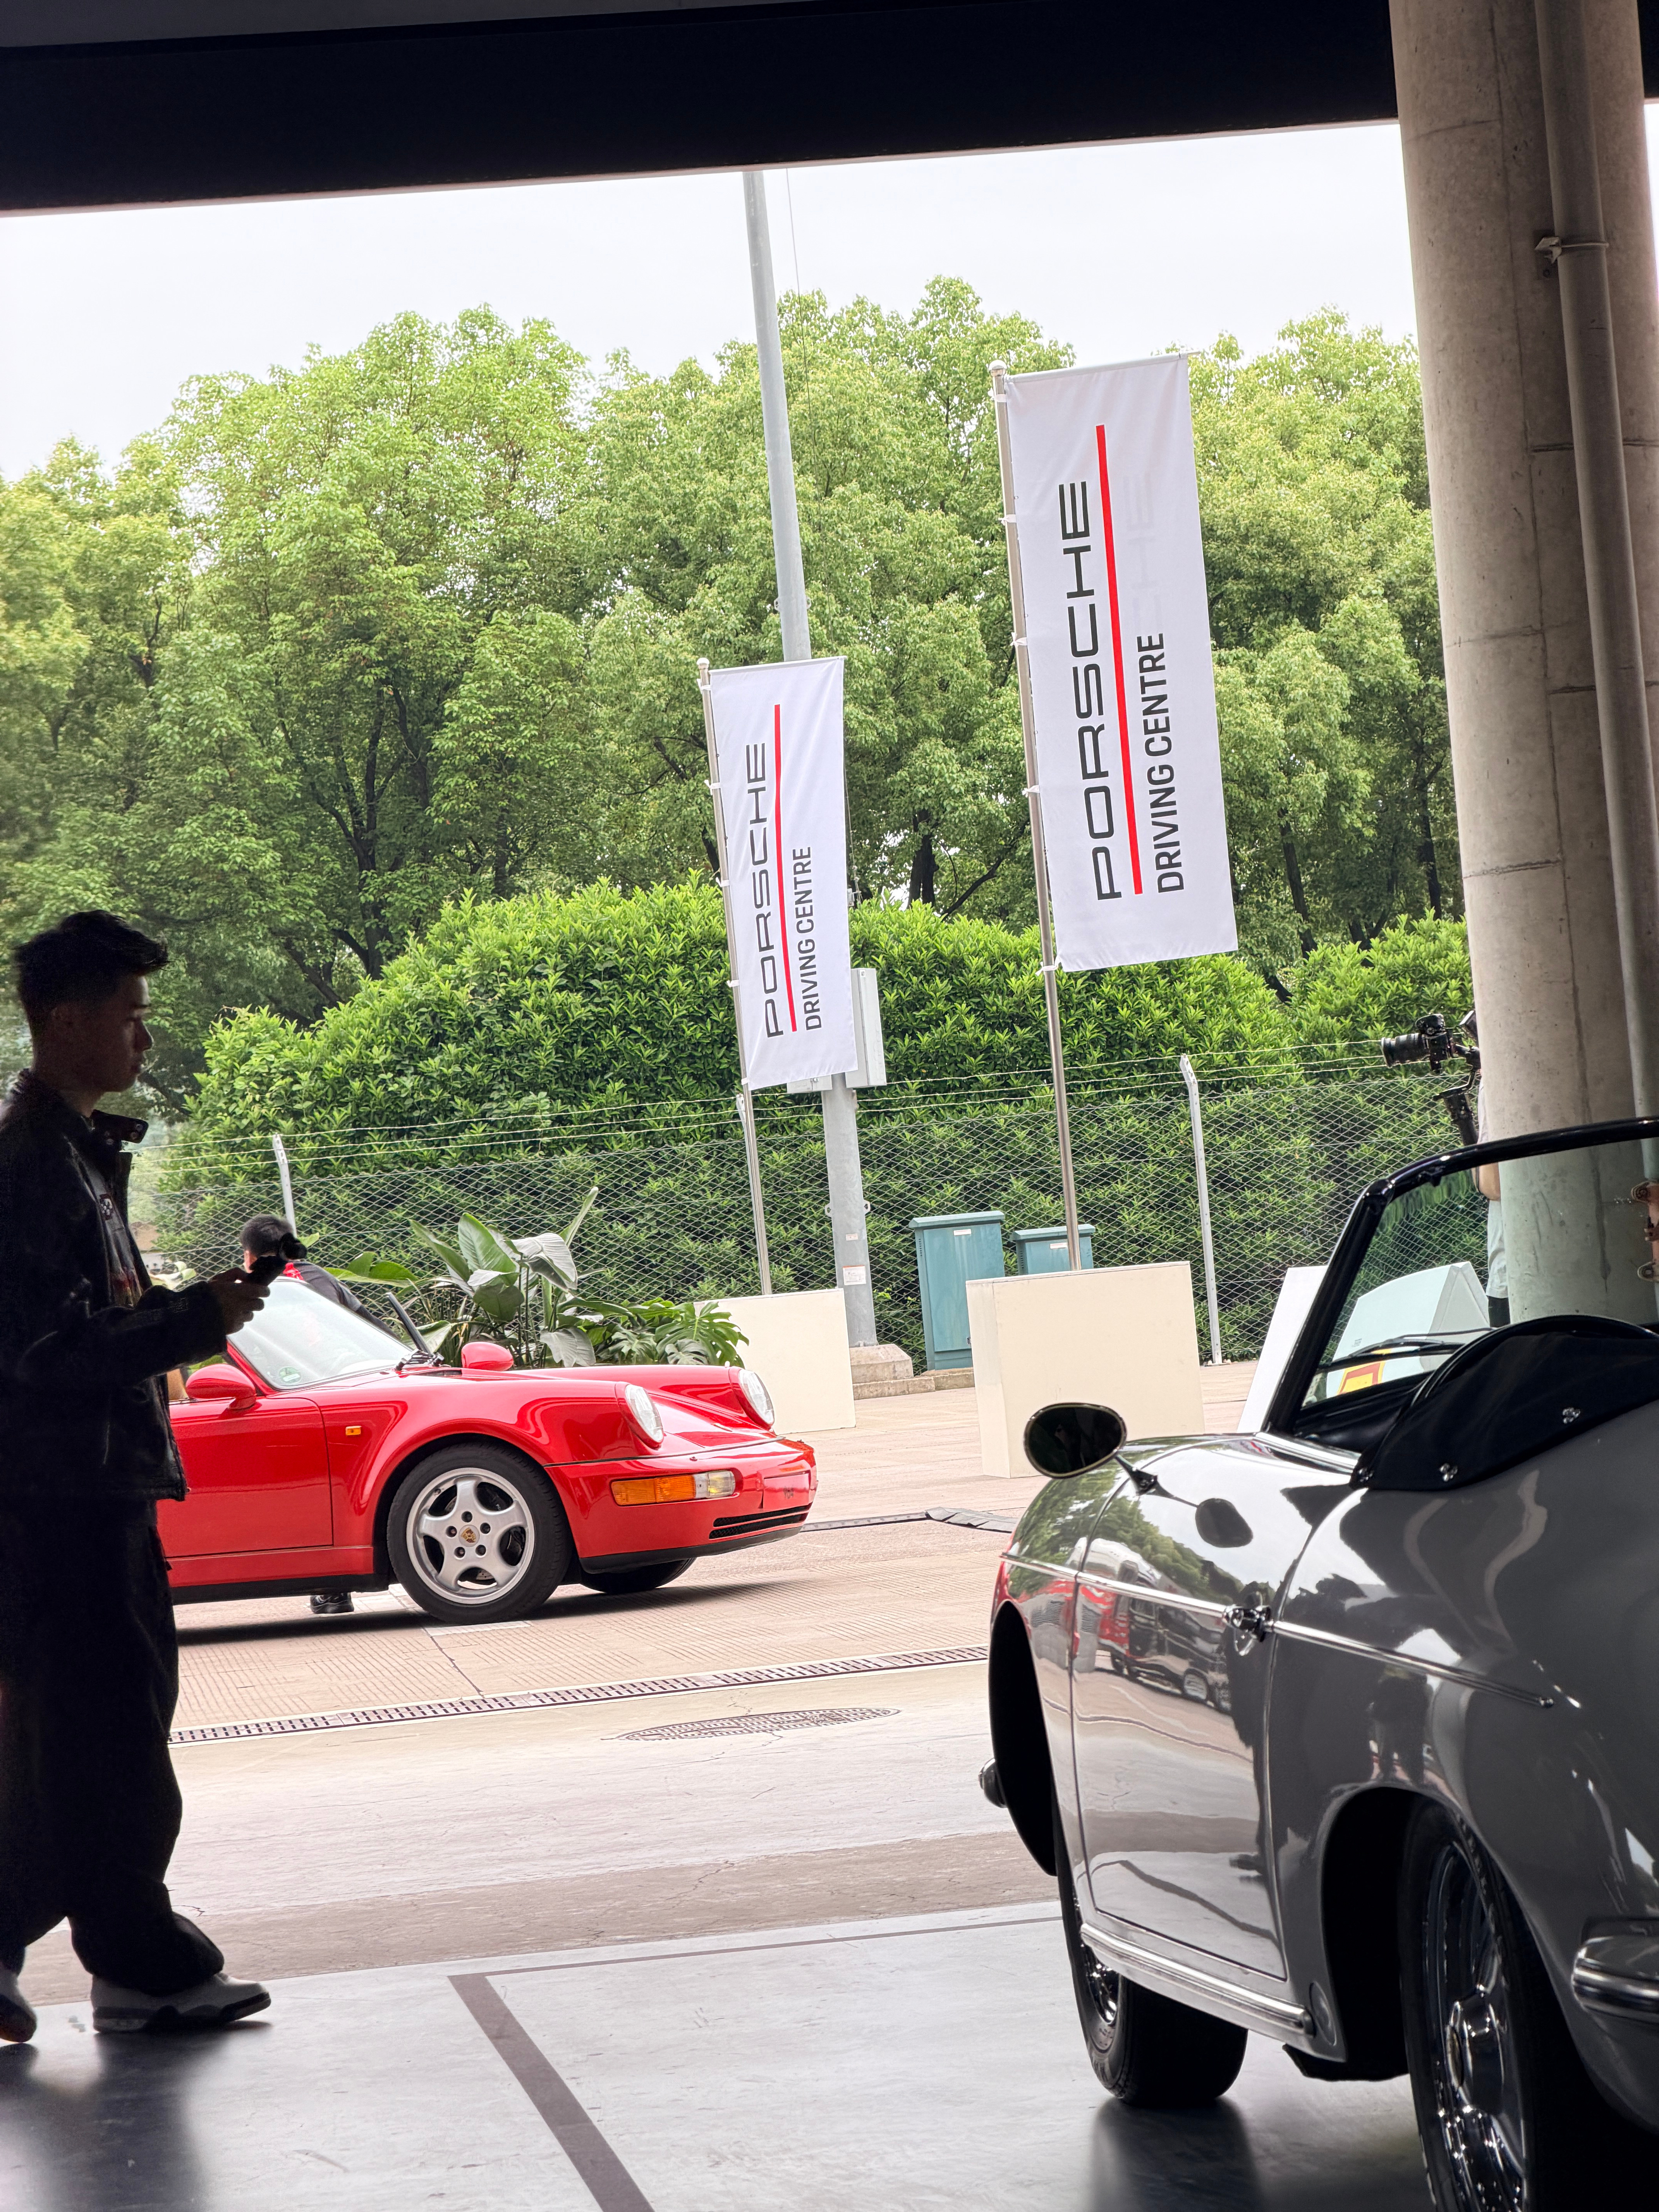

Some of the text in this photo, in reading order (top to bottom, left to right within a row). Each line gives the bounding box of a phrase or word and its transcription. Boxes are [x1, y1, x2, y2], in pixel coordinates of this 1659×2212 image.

[1059, 481, 1121, 900] PORSCHE
[1137, 633, 1172, 757] CENTRE
[746, 743, 784, 1038] PORSCHE
[1147, 764, 1184, 893] DRIVING
[792, 847, 822, 1030] DRIVING CENTRE
